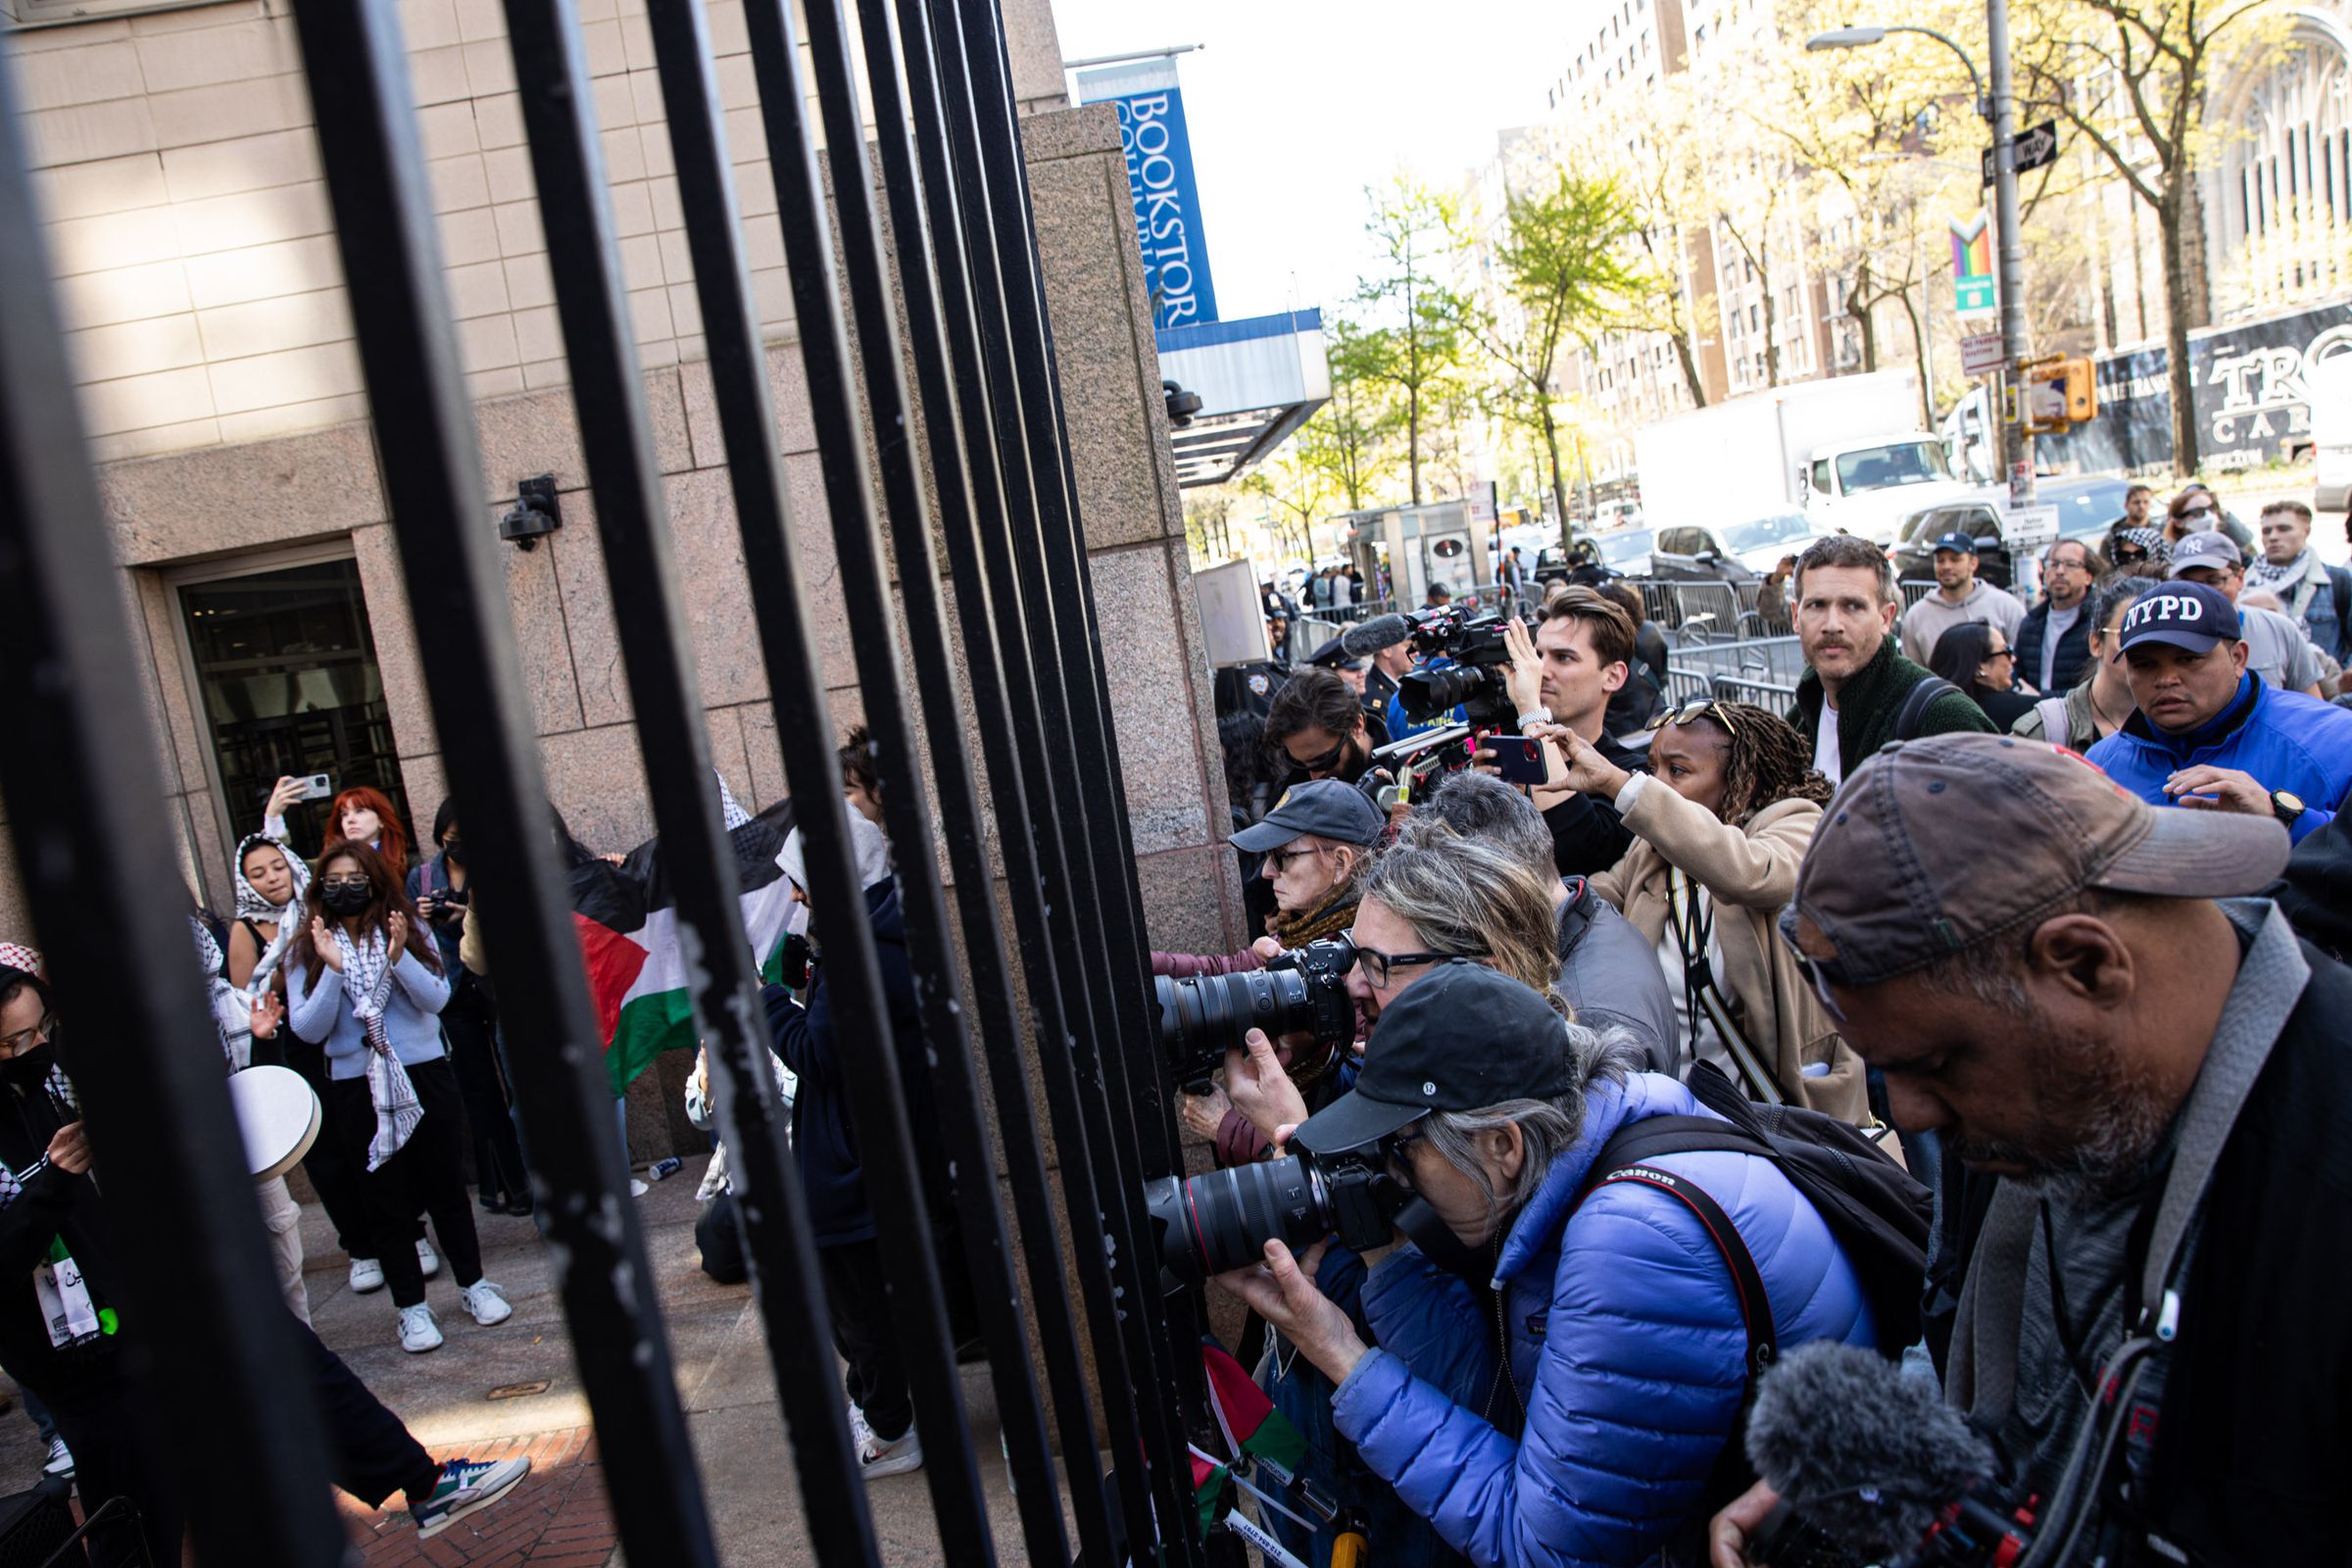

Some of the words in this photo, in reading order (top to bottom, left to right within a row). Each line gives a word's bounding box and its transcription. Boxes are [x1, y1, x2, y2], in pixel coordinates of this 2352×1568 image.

[2023, 137, 2045, 158] WAY
[1130, 93, 1200, 329] BOOKSTOR
[2124, 595, 2203, 633] NYPD
[1606, 1168, 1676, 1187] Canon
